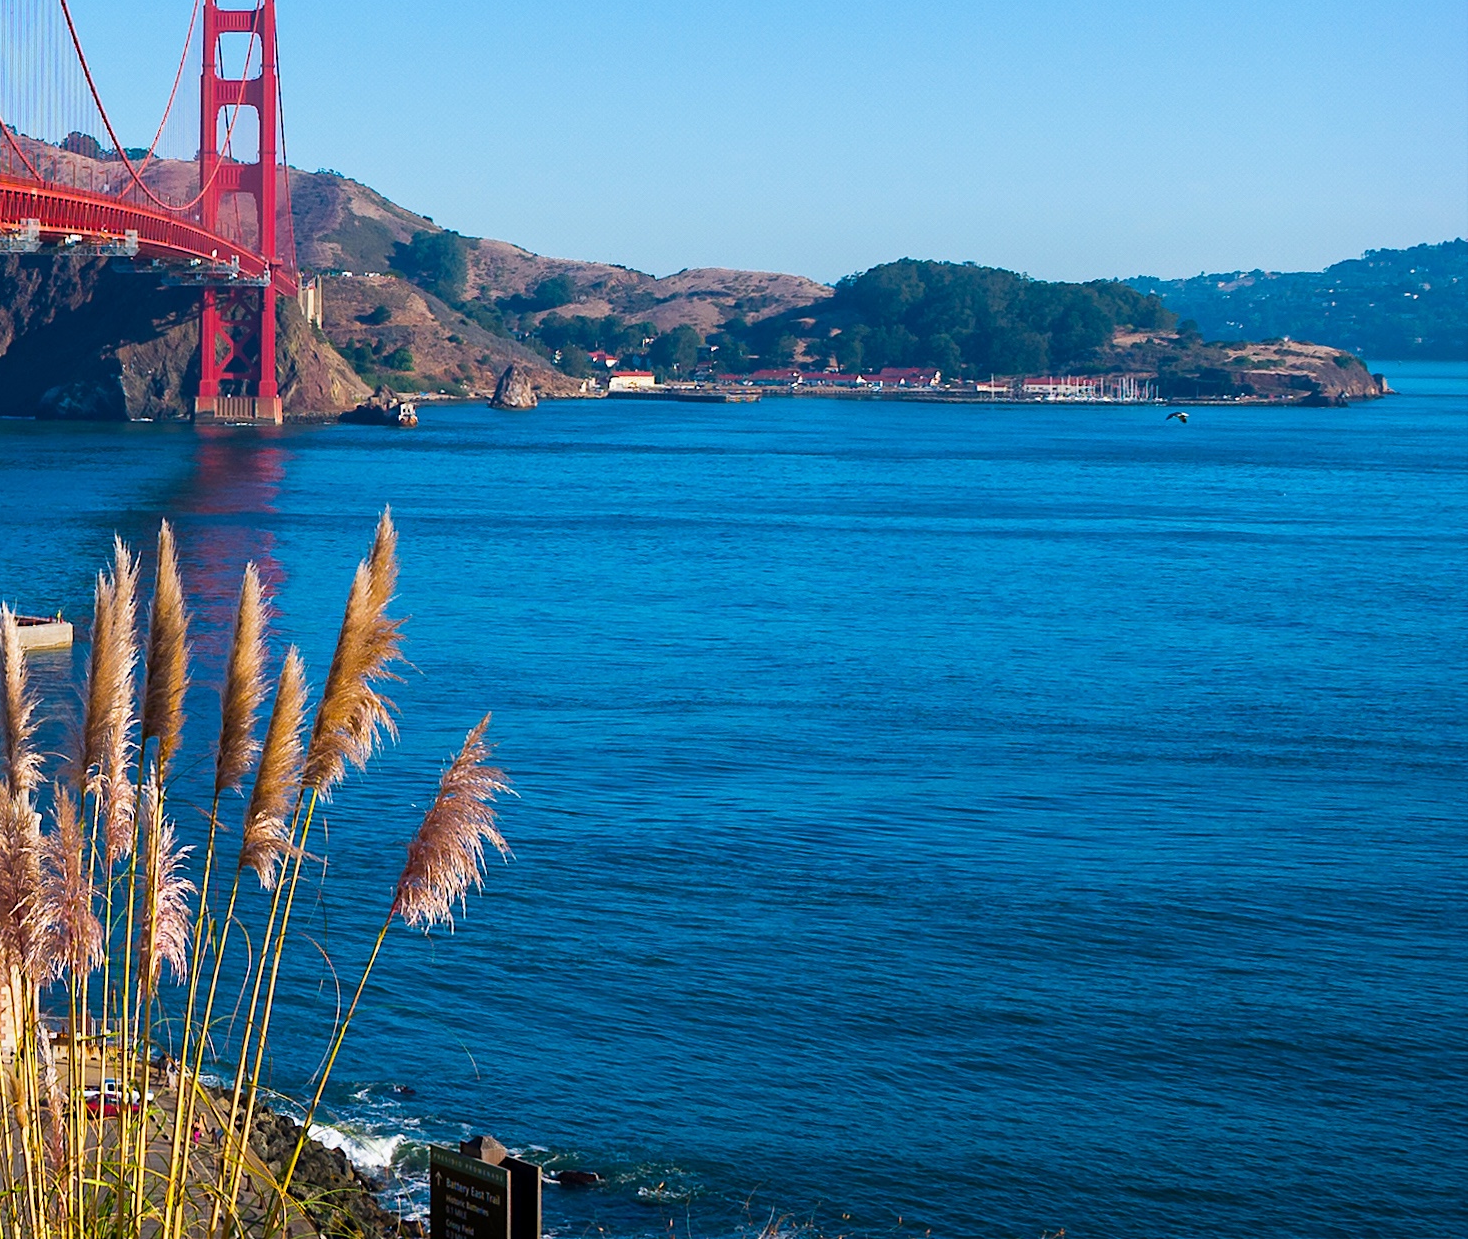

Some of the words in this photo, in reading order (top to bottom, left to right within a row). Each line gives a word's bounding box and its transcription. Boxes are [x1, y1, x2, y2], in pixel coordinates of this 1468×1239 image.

[433, 1153, 463, 1168] PRESIDIO
[465, 1163, 504, 1182] PROMENADE
[446, 1177, 469, 1197] Battery
[471, 1186, 484, 1200] East
[486, 1191, 501, 1206] Trail
